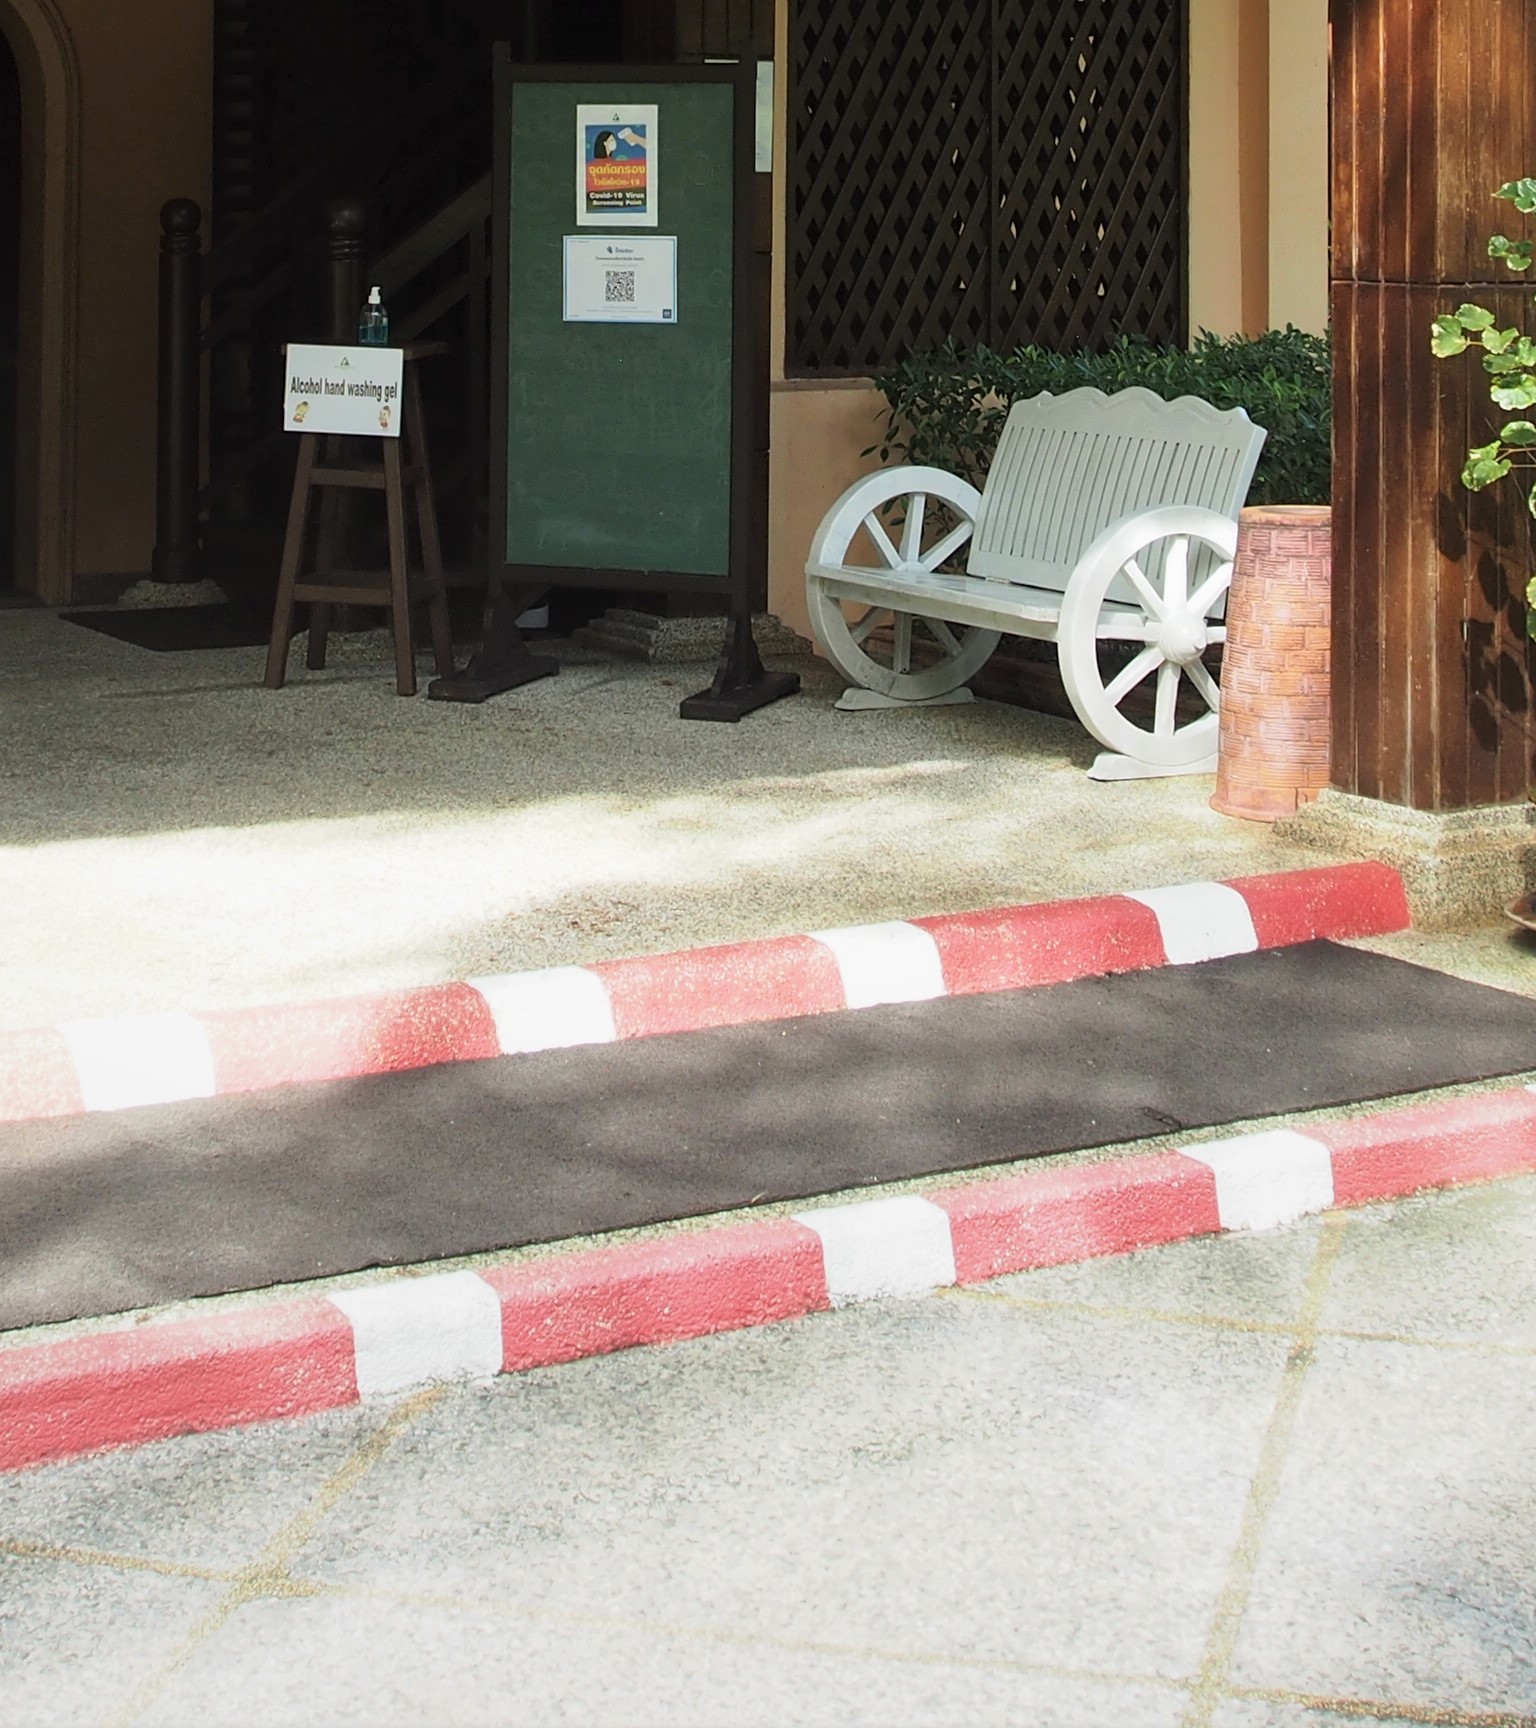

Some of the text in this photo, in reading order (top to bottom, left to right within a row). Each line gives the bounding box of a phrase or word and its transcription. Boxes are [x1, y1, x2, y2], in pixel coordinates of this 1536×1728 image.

[589, 191, 645, 199] Covid-19 Virus
[290, 375, 398, 403] Alcohol hand washing gel
